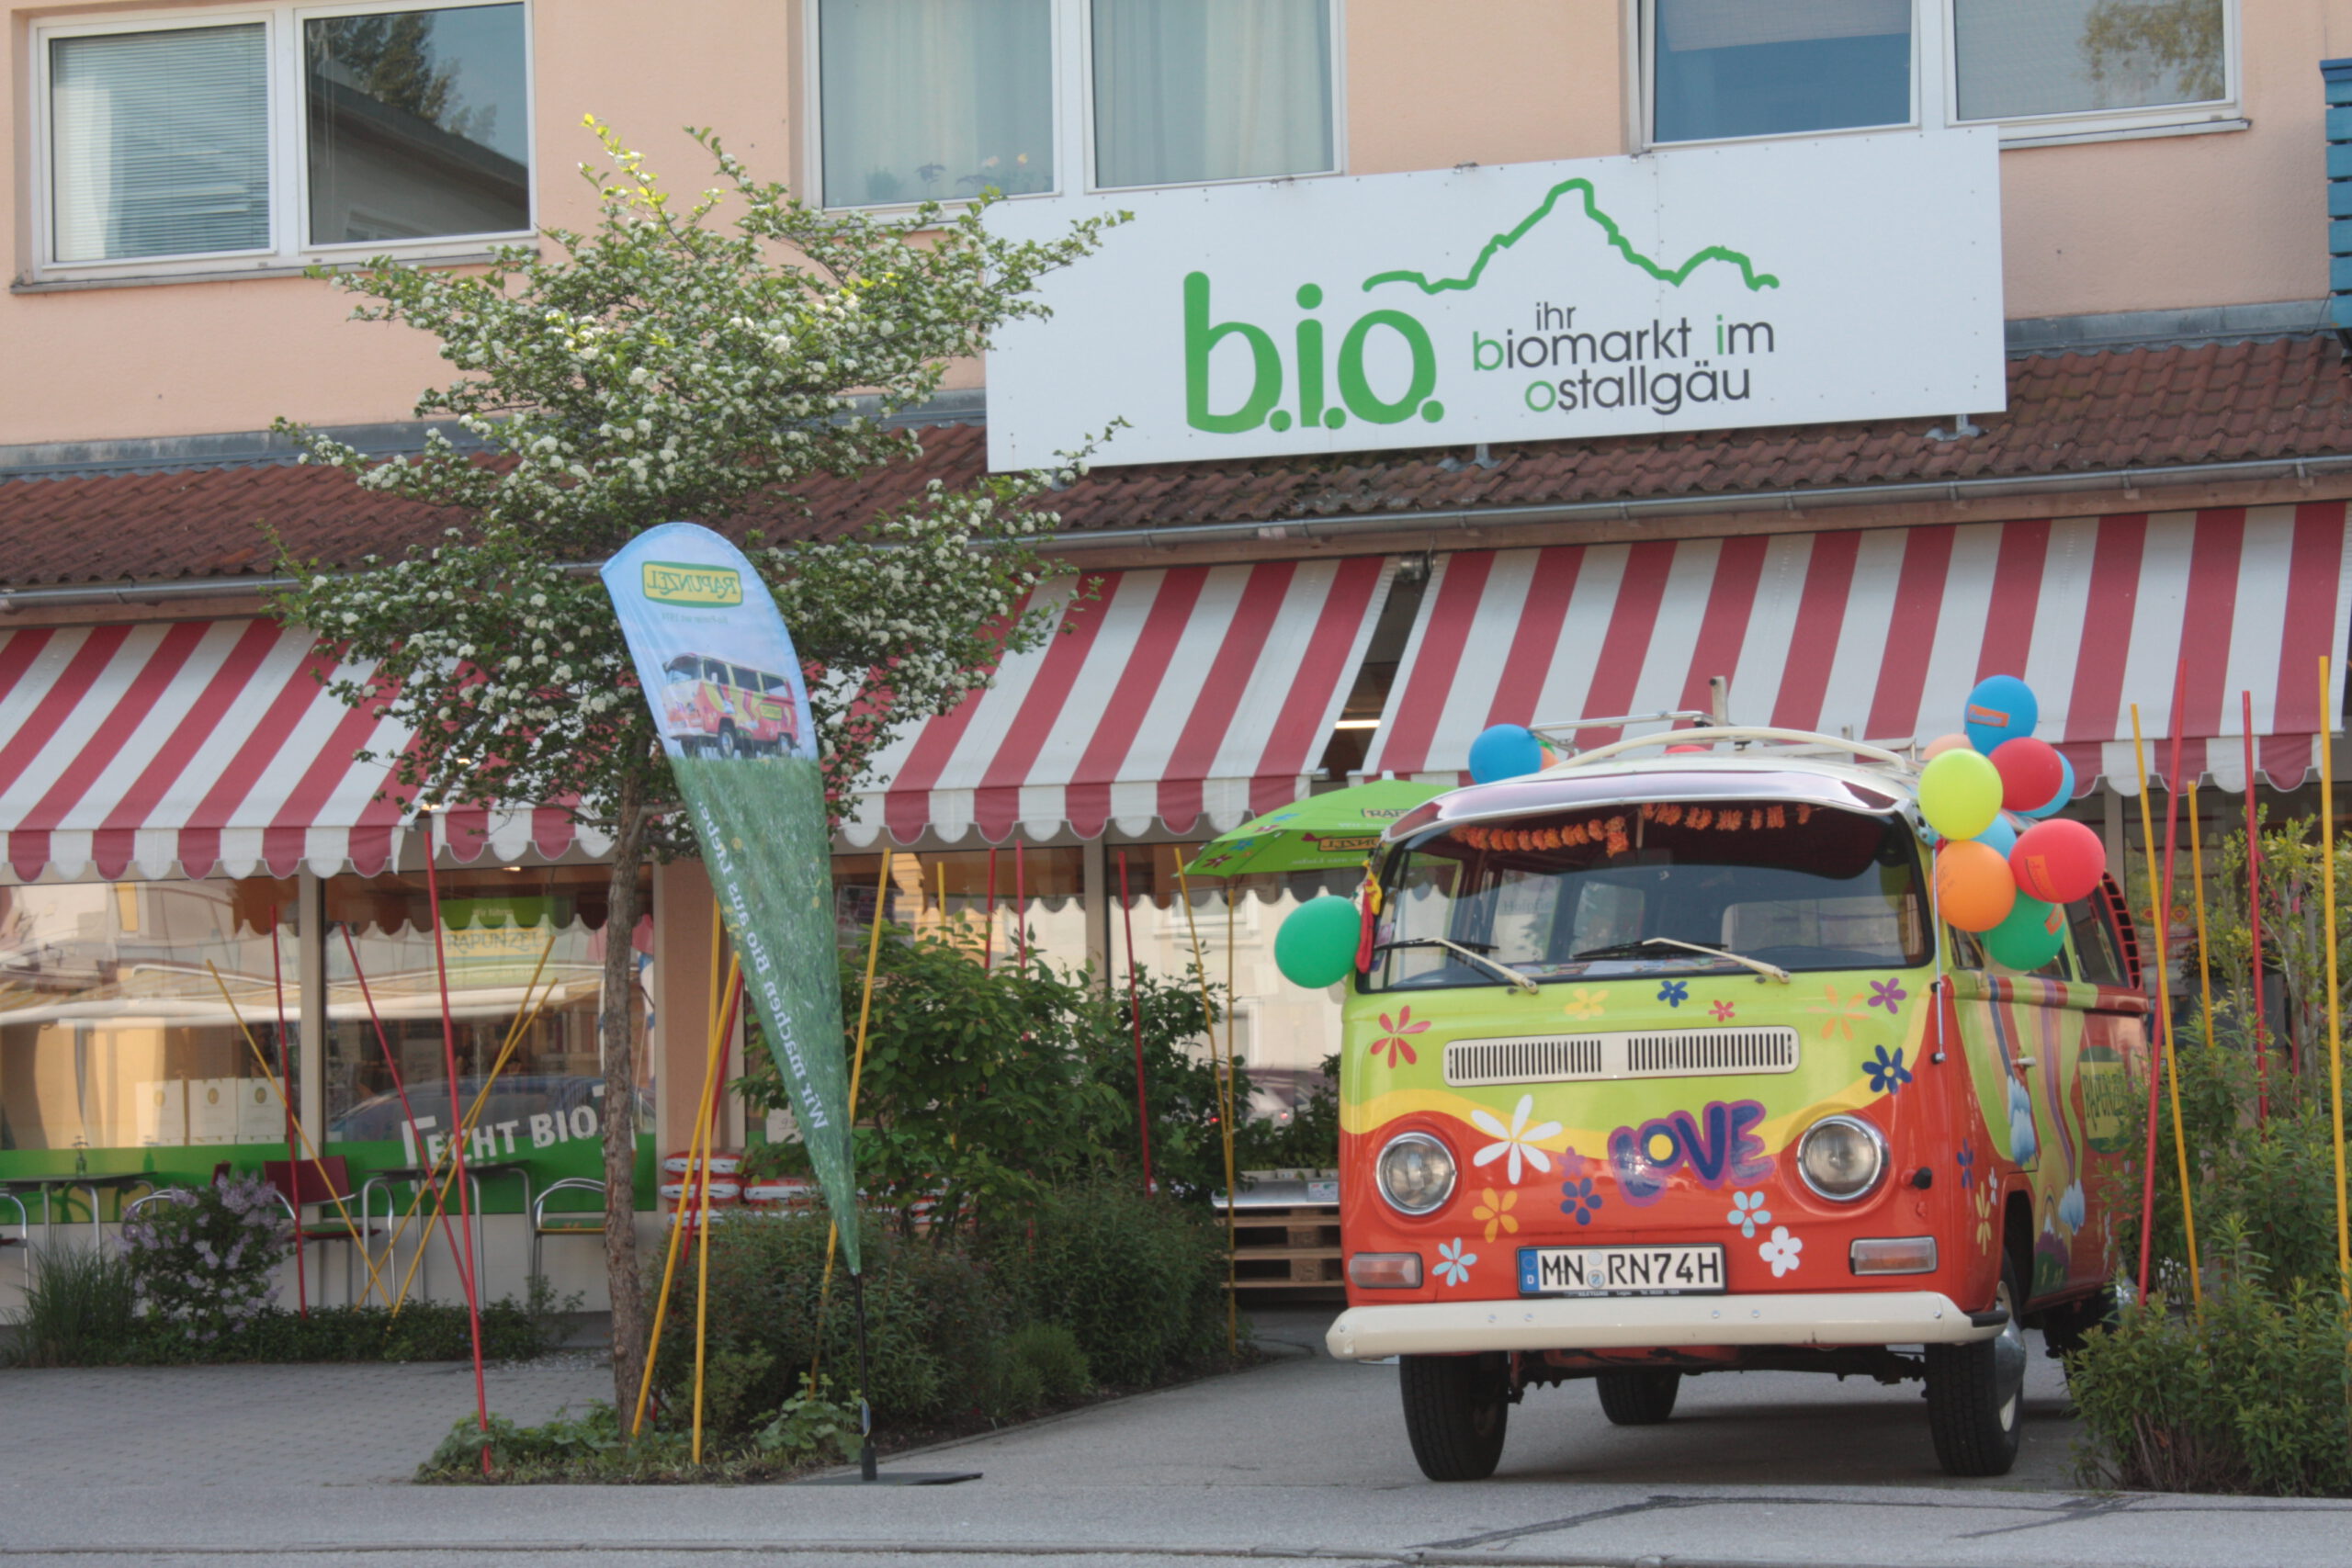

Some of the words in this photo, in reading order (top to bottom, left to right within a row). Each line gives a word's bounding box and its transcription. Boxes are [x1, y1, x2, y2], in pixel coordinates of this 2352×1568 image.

[1536, 301, 1577, 332] ihr
[1473, 317, 1692, 371] biomarkt
[1715, 314, 1775, 355] im
[1524, 361, 1751, 415] ostallgäu
[447, 931, 544, 954] RAPUNZEL
[1608, 1099, 1775, 1206] LOVE
[1542, 1254, 1585, 1287] MN
[1608, 1252, 1719, 1286] RN74H
